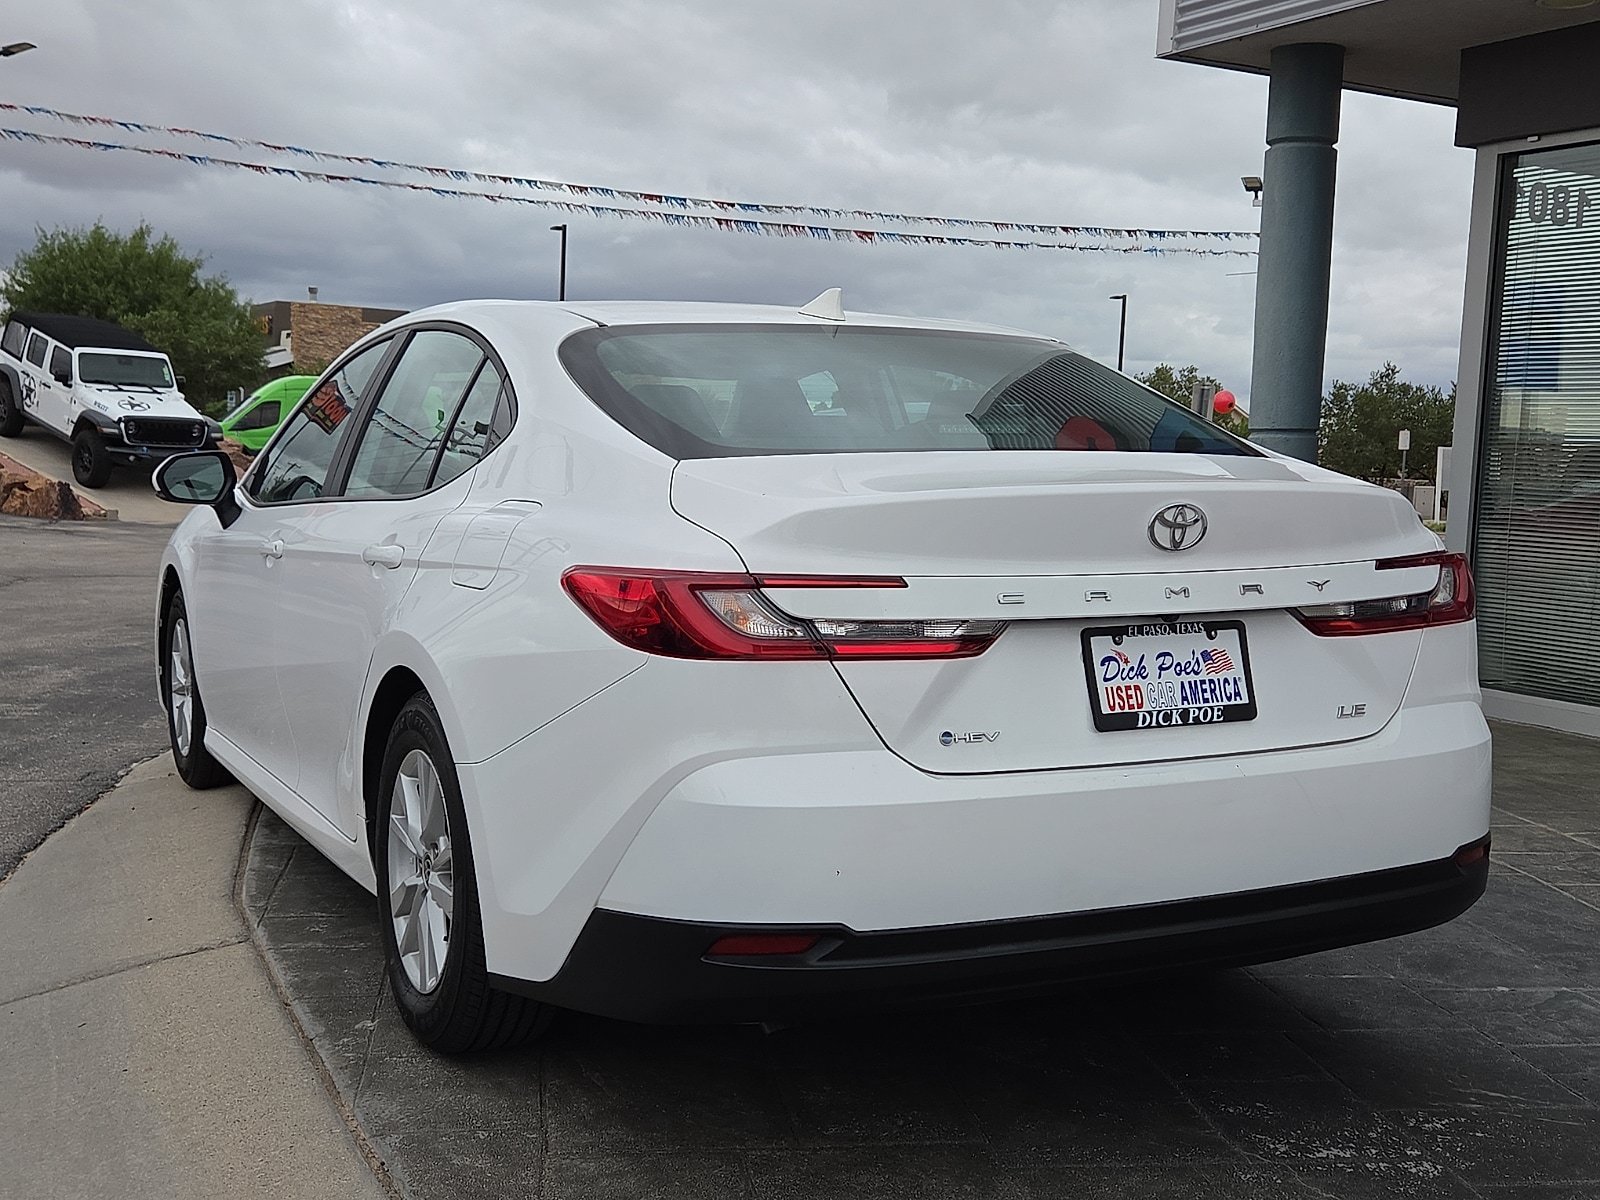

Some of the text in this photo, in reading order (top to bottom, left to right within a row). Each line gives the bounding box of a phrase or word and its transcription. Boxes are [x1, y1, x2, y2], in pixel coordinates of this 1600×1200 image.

[997, 579, 1331, 605] CAMRY
[1128, 626, 1140, 637] EL
[1175, 622, 1205, 634] TEXAS
[1099, 649, 1203, 682] Dick Poe's
[1105, 677, 1242, 712] USED CAR AMERICA
[1136, 706, 1224, 728] DICK POE
[1337, 703, 1366, 719] LE
[954, 731, 1001, 744] HEV
